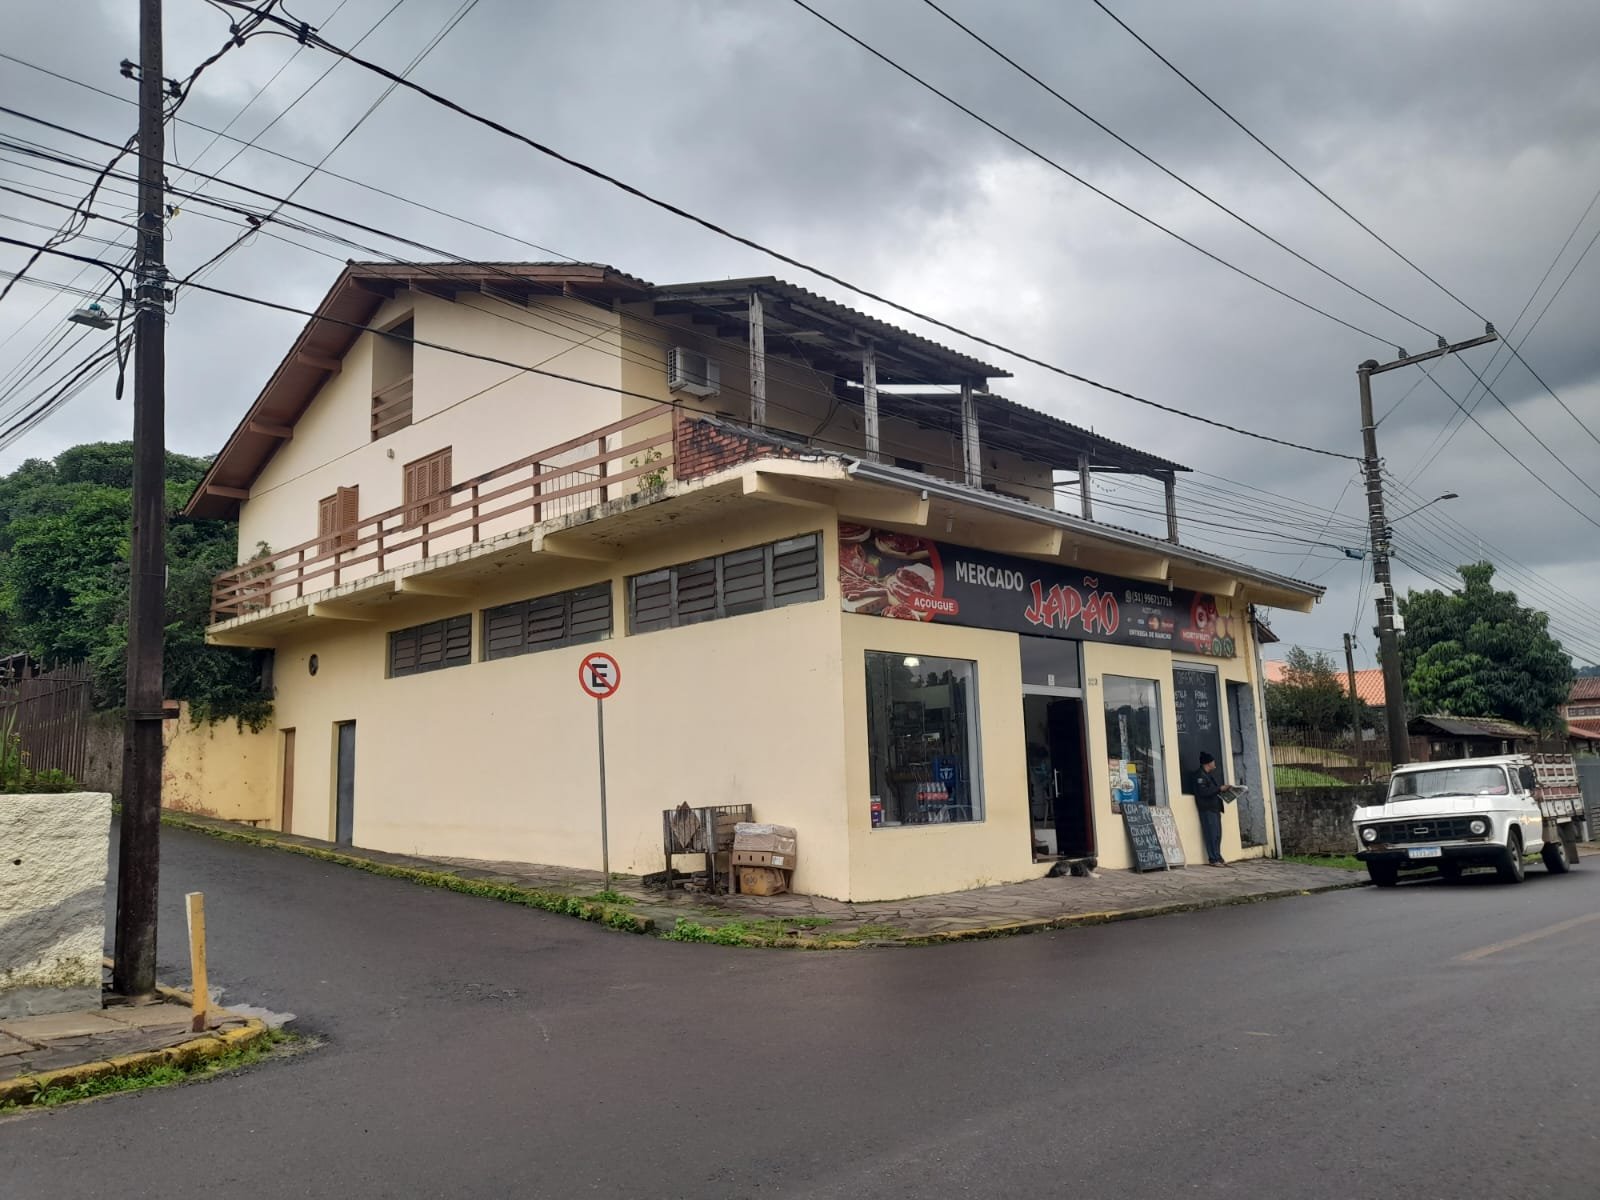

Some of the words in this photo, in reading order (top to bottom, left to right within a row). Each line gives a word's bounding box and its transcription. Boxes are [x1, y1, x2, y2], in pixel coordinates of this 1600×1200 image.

[955, 560, 1023, 591] MERCADO
[913, 597, 954, 612] AÇOUGUE
[1024, 576, 1119, 636] JAPÃO
[1132, 591, 1143, 604] (51)
[592, 664, 608, 688] E
